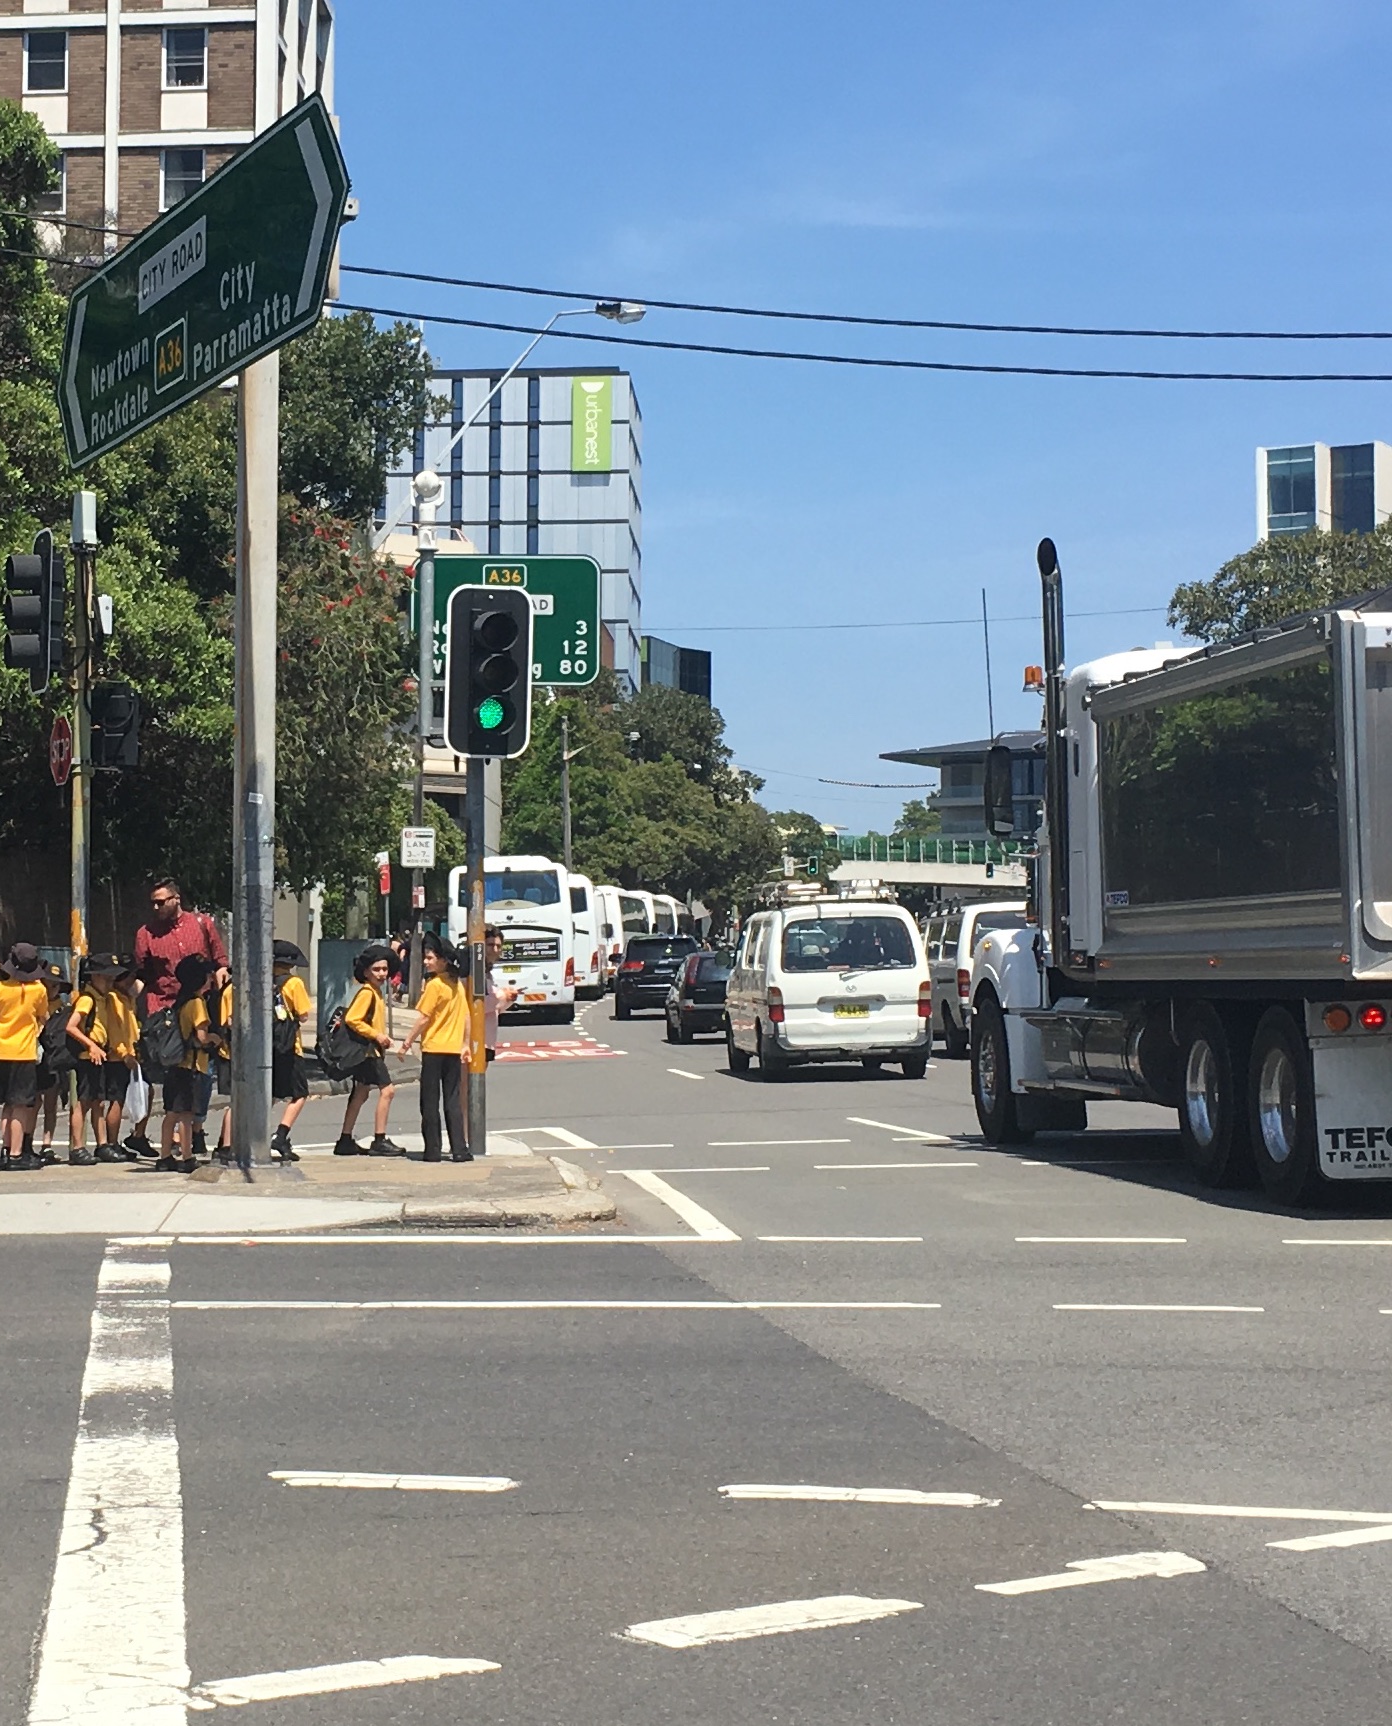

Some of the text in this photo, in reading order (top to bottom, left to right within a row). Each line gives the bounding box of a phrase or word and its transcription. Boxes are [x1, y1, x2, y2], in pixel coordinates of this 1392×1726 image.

[141, 231, 204, 300] CITY ROAD
[219, 260, 256, 313] City
[157, 336, 183, 377] A36
[193, 292, 291, 381] Parramatta
[90, 336, 150, 401] Newtown
[91, 386, 149, 446] Rockdale
[585, 394, 603, 465] urbanest
[488, 569, 522, 583] A36
[563, 640, 588, 655] 12
[575, 620, 588, 635] 3
[559, 659, 587, 675] 80
[494, 1048, 614, 1060] ANE
